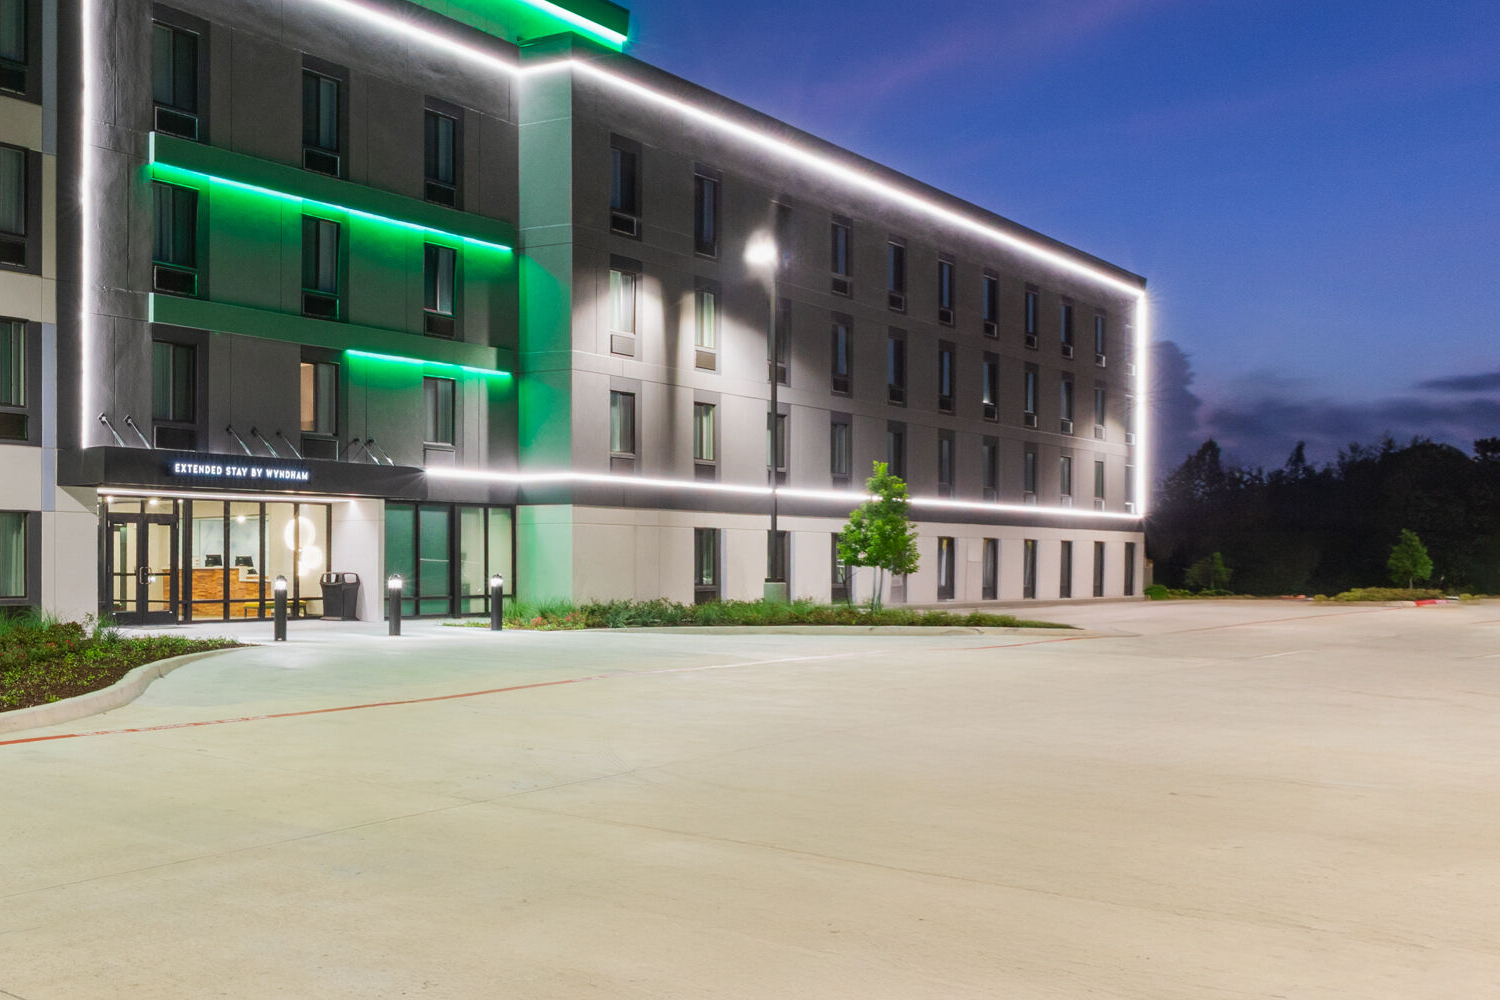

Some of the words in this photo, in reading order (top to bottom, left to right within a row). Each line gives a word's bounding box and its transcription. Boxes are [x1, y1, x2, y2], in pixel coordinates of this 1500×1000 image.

[174, 463, 223, 475] EXTENDED
[225, 466, 248, 477] STAY
[251, 468, 263, 478] BY
[266, 469, 309, 480] WYNDHAM
